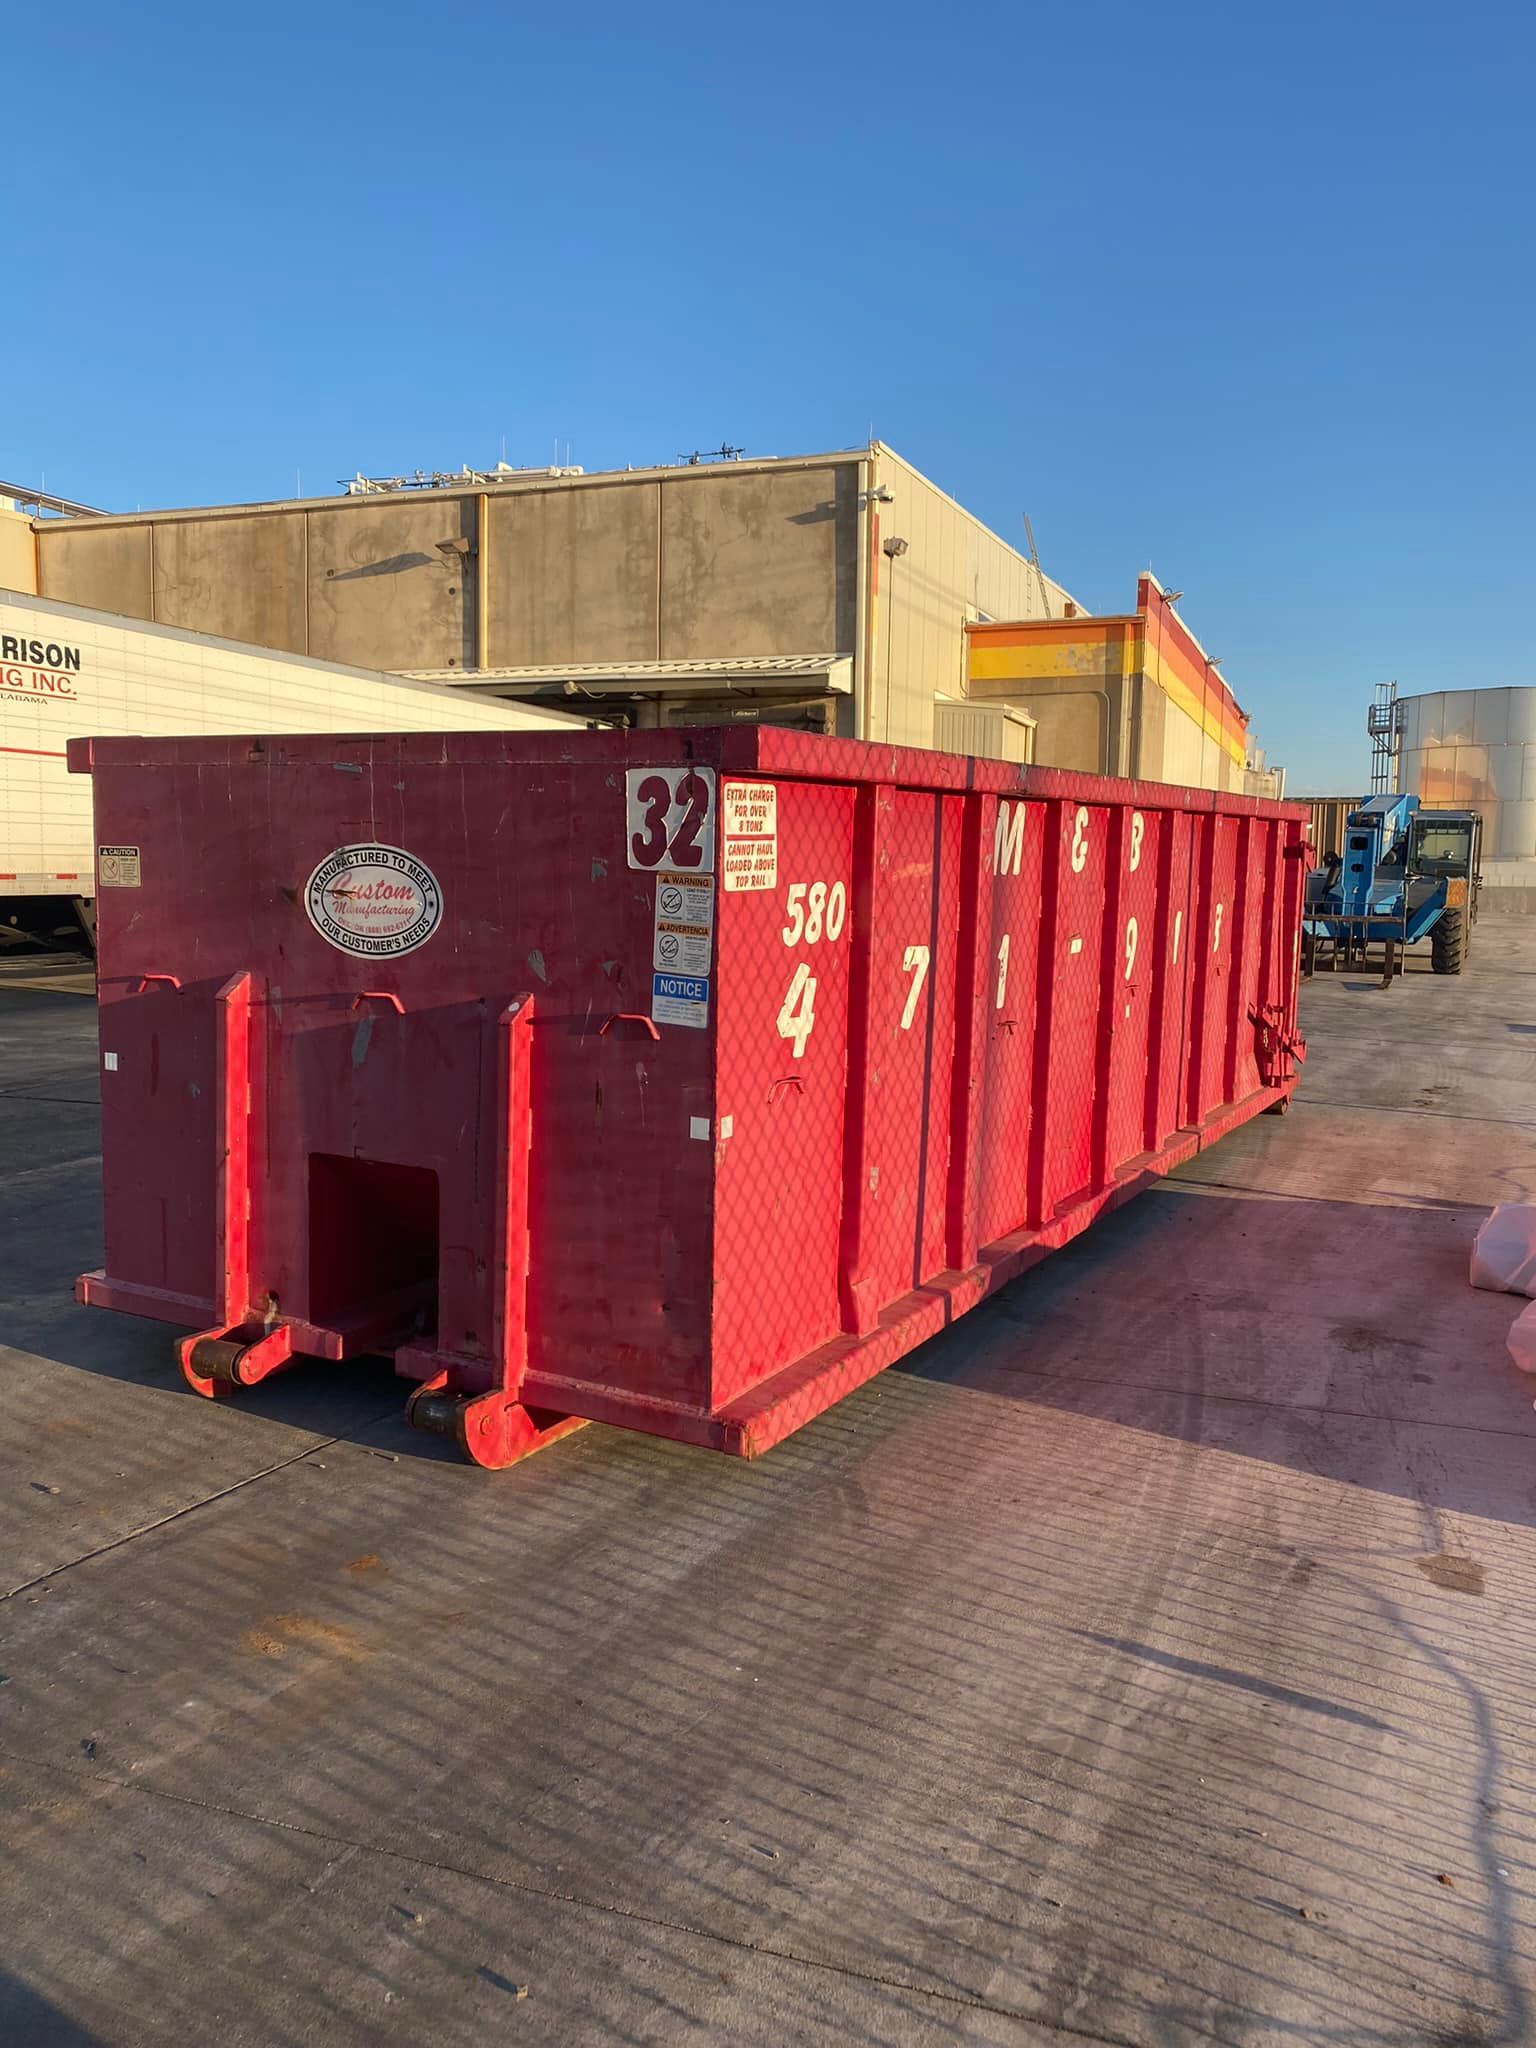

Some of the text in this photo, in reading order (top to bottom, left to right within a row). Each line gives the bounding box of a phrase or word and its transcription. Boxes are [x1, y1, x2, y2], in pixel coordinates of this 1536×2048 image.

[2, 635, 80, 670] RISON
[32, 672, 77, 695] INC.
[726, 788, 775, 802] EXTRA CHARGE
[631, 770, 710, 867] 32
[734, 805, 767, 818] FOR OVER
[746, 820, 763, 832] TONS
[109, 847, 136, 857] CAUTION
[728, 843, 774, 856] CANNOT HAUL
[726, 858, 775, 872] LOADED ABOVE
[313, 851, 434, 895] MANUFACTURED TO MEET
[331, 872, 415, 901] Custom
[672, 876, 709, 888] WARNING
[735, 874, 766, 888] TOP RAIL
[782, 880, 846, 947] 580
[322, 917, 340, 939] OUR
[342, 932, 401, 951] CUSTOMER'S
[402, 917, 431, 945] NEEDS
[666, 922, 709, 936] ADVERTENCIA
[660, 978, 703, 998] NOTICE
